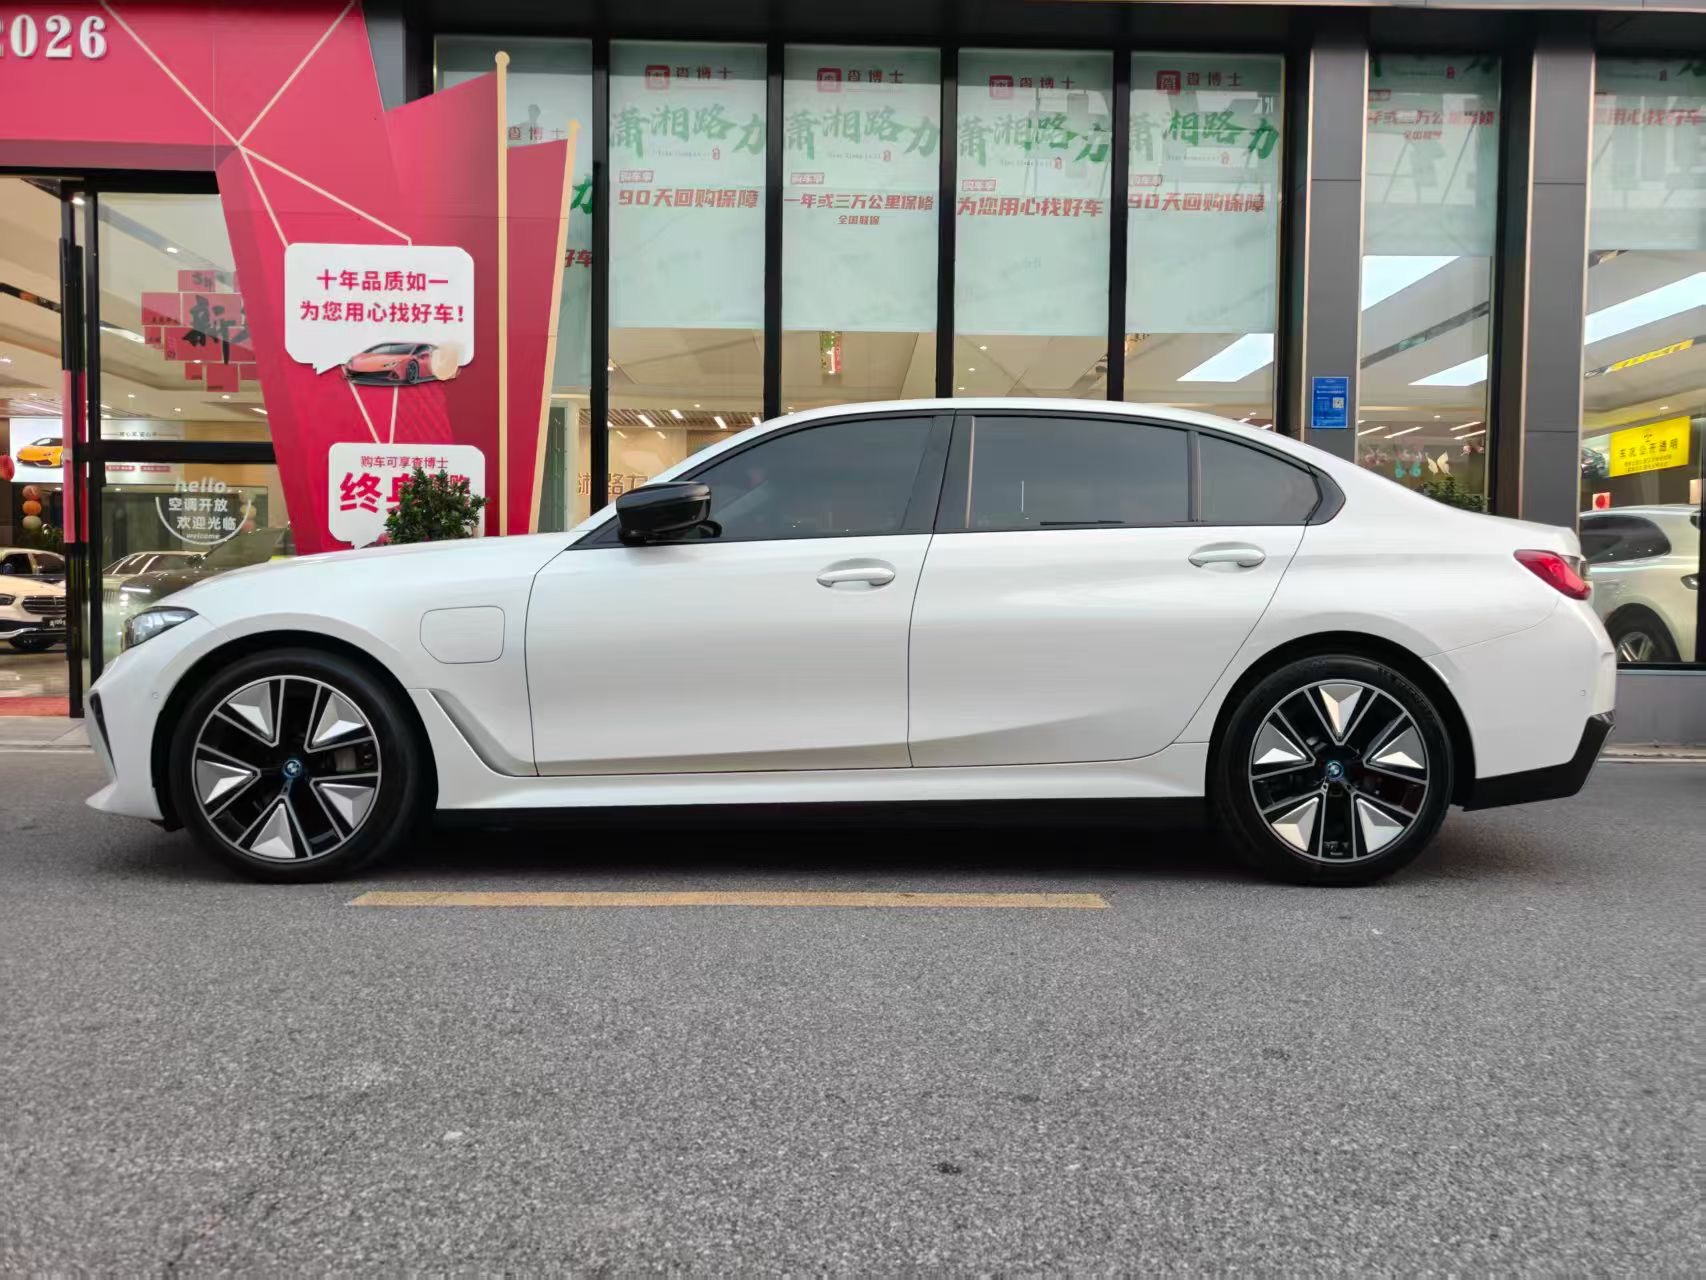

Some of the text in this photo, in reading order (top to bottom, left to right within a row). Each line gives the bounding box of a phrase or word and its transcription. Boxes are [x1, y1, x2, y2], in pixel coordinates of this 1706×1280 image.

[0, 14, 107, 59] 026
[618, 189, 759, 209] 90天回购保障
[783, 193, 934, 210] 一年或三万公里保修
[956, 197, 1104, 217] 为您用心找好车
[1128, 192, 1265, 212] 90天回购保障
[316, 269, 449, 291] 十年品质如一
[300, 301, 464, 324] 为您用心找好车!
[360, 455, 449, 469] 购车可享查博士
[168, 497, 229, 512] 空调开放
[176, 516, 237, 531] 欢迎光临
